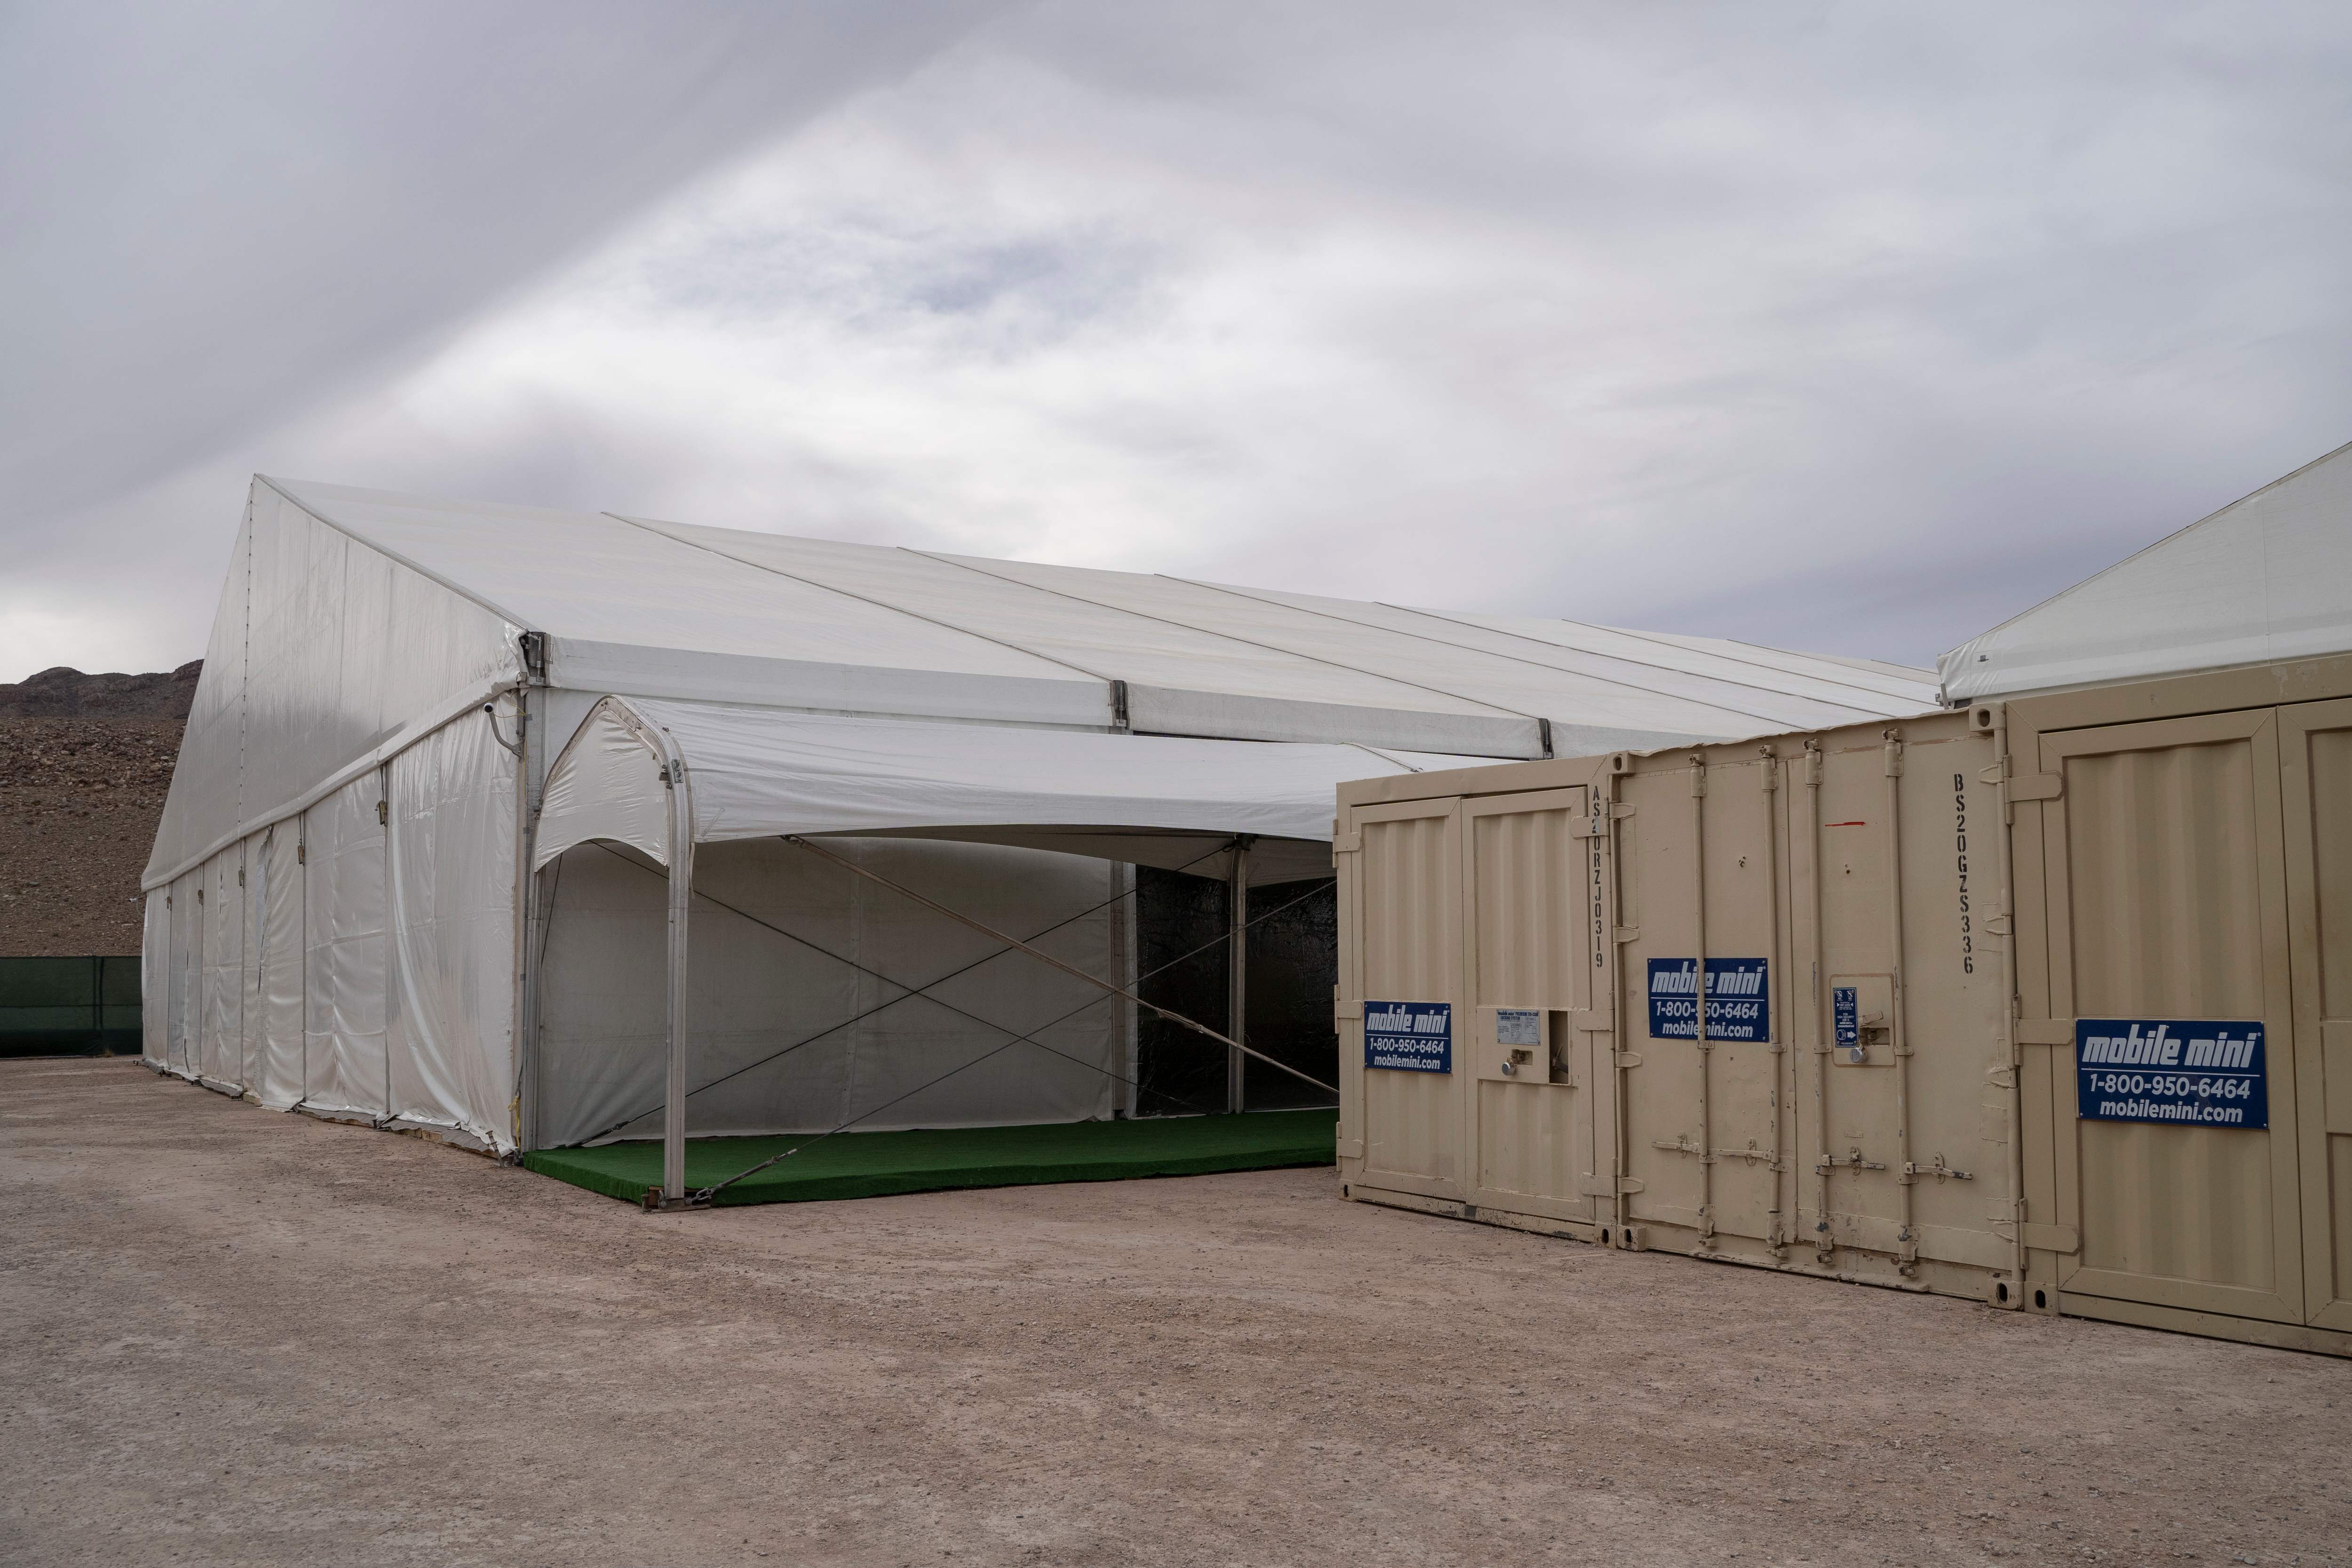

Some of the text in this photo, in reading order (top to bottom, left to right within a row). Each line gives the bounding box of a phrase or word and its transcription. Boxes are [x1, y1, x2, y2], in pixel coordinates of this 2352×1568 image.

[1954, 773, 1973, 974] BS20GZS336
[1651, 961, 1763, 994] mobie mini
[1367, 1004, 1448, 1033] mobile mini
[1656, 1001, 1758, 1019] 1-800-50-6464
[1370, 1037, 1444, 1054] 1-800-950-6464
[2082, 1024, 2257, 1067] mobile mini
[1374, 1054, 1440, 1069] mobilemini.com
[2090, 1074, 2250, 1099] 1-800-950-6464
[2099, 1099, 2242, 1122] mobilemini.com
